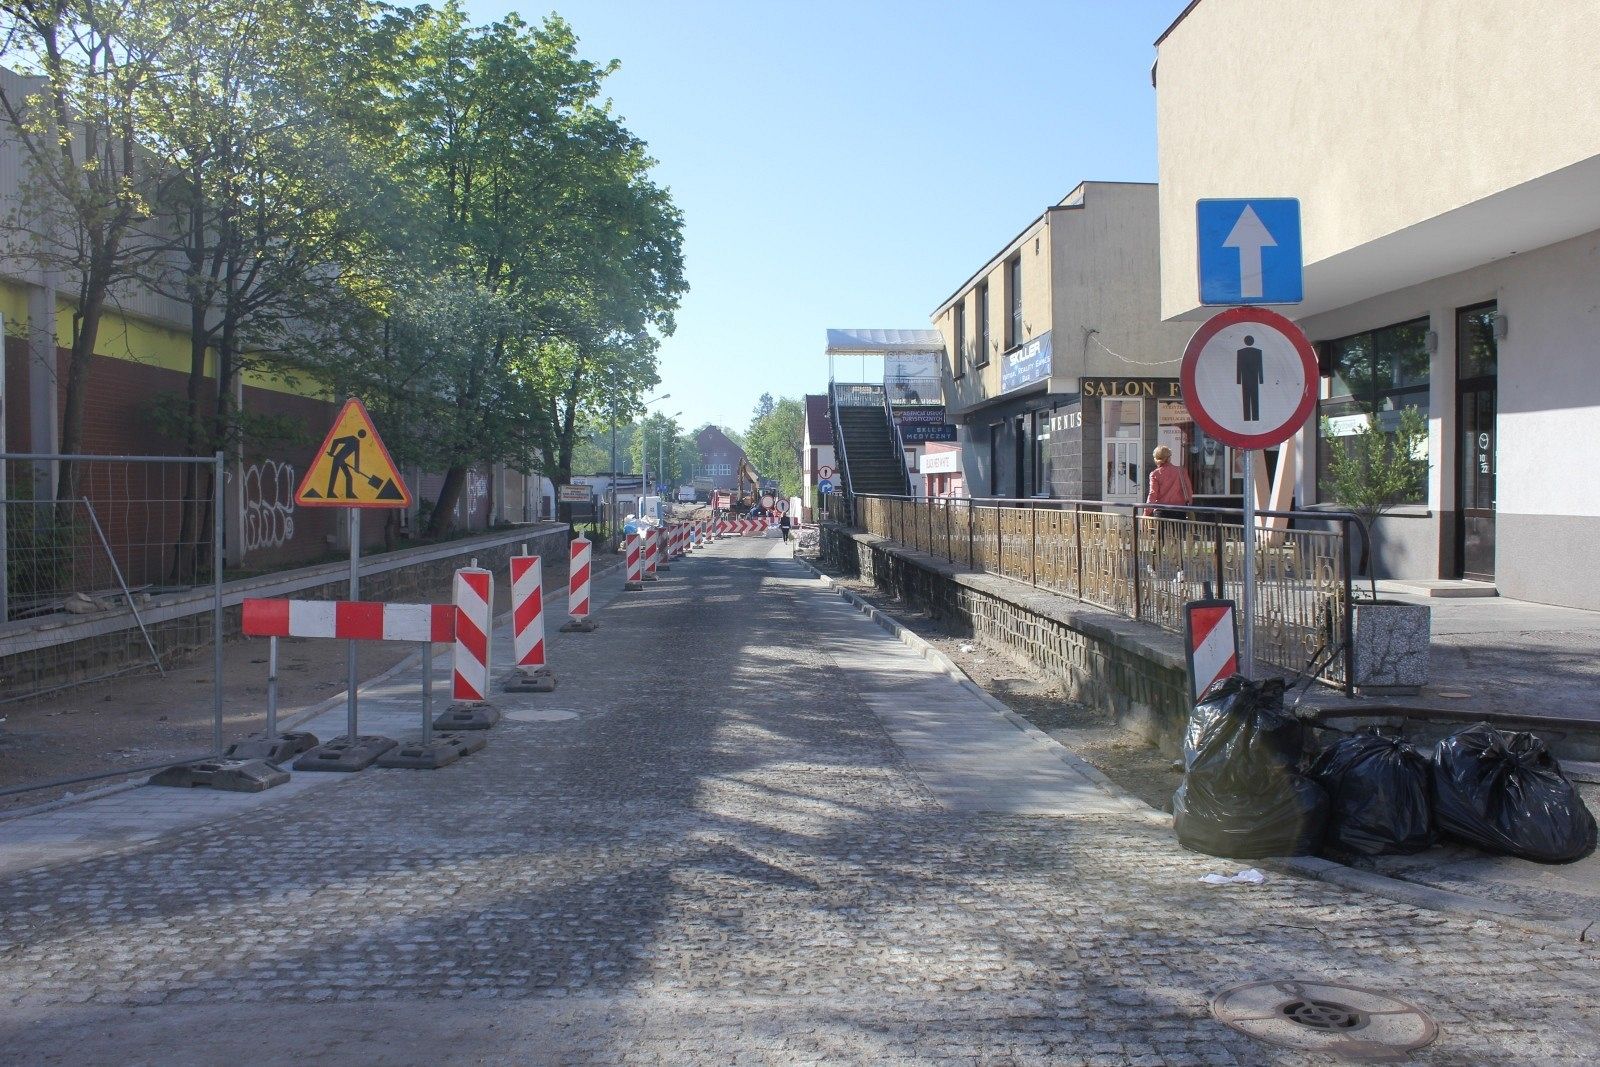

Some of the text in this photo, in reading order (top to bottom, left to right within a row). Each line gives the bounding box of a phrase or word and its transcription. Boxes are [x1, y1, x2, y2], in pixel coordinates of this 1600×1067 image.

[1009, 341, 1041, 367] SKILLER
[1018, 363, 1035, 375] REALITY
[1084, 381, 1182, 397] SALON F
